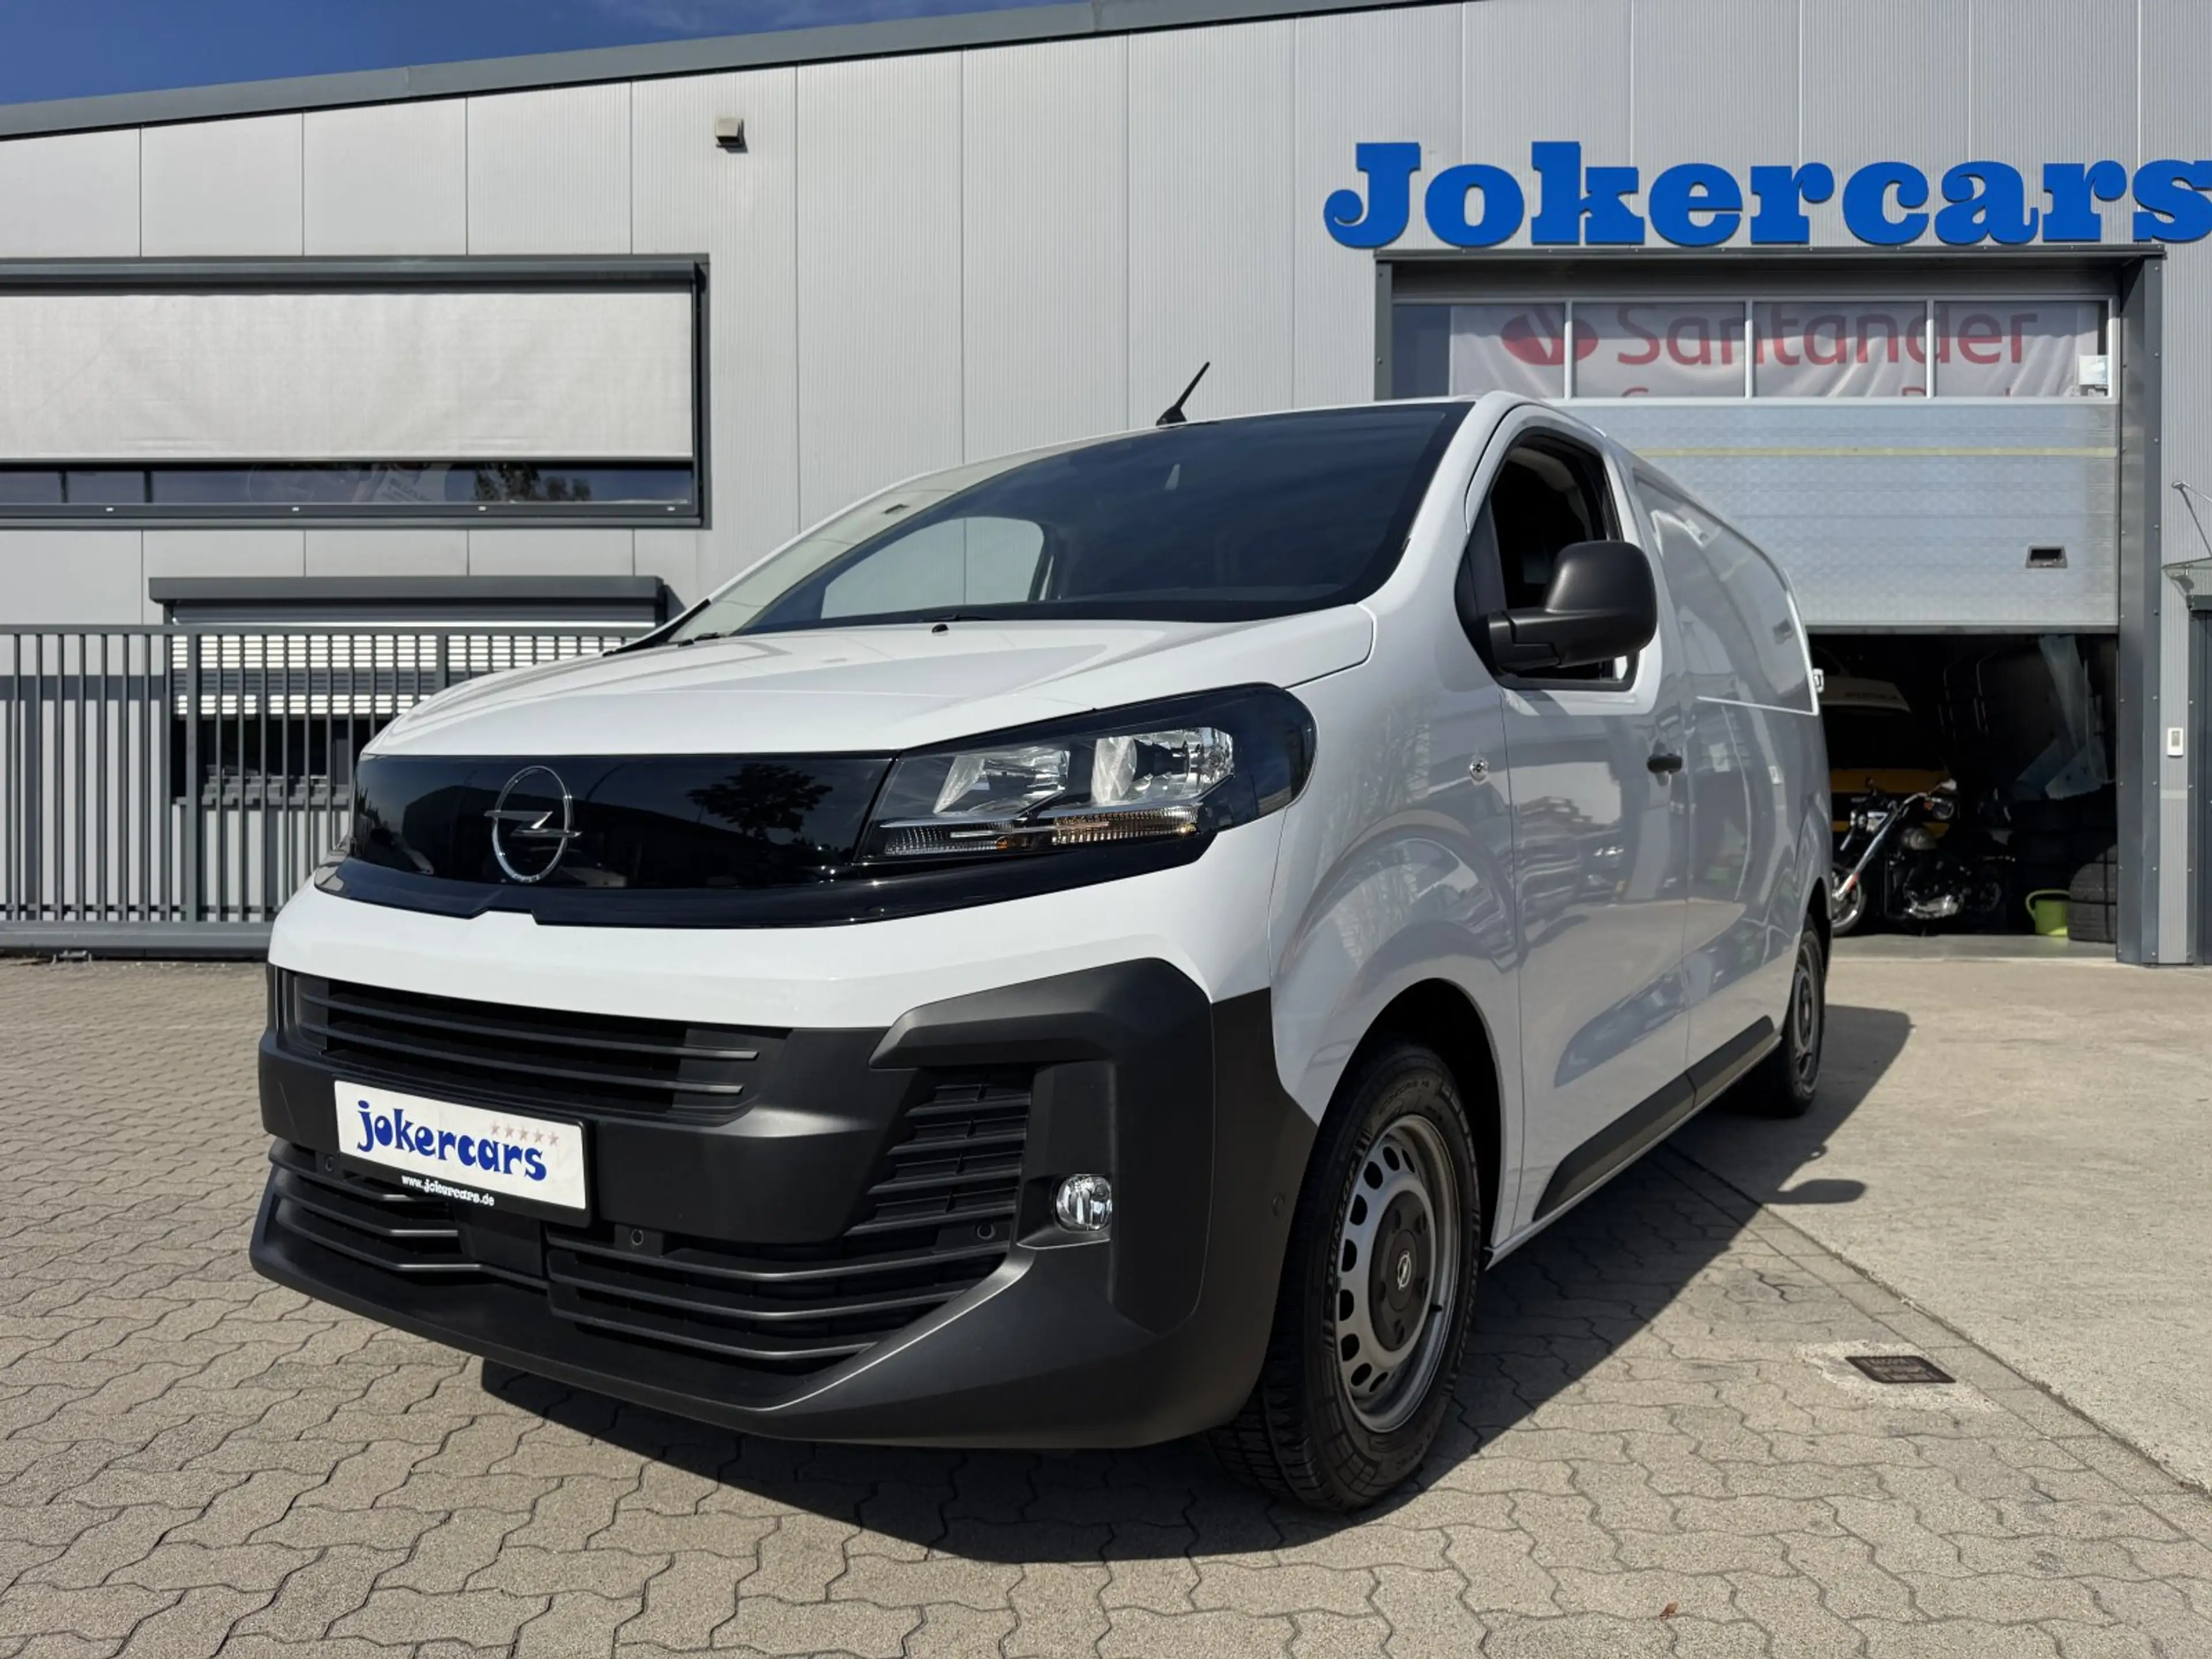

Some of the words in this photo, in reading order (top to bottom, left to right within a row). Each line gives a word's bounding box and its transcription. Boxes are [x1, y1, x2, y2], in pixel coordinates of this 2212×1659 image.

[1324, 141, 2212, 249] Jokercars
[1618, 303, 2037, 365] Santander
[357, 1100, 547, 1181] jokercars
